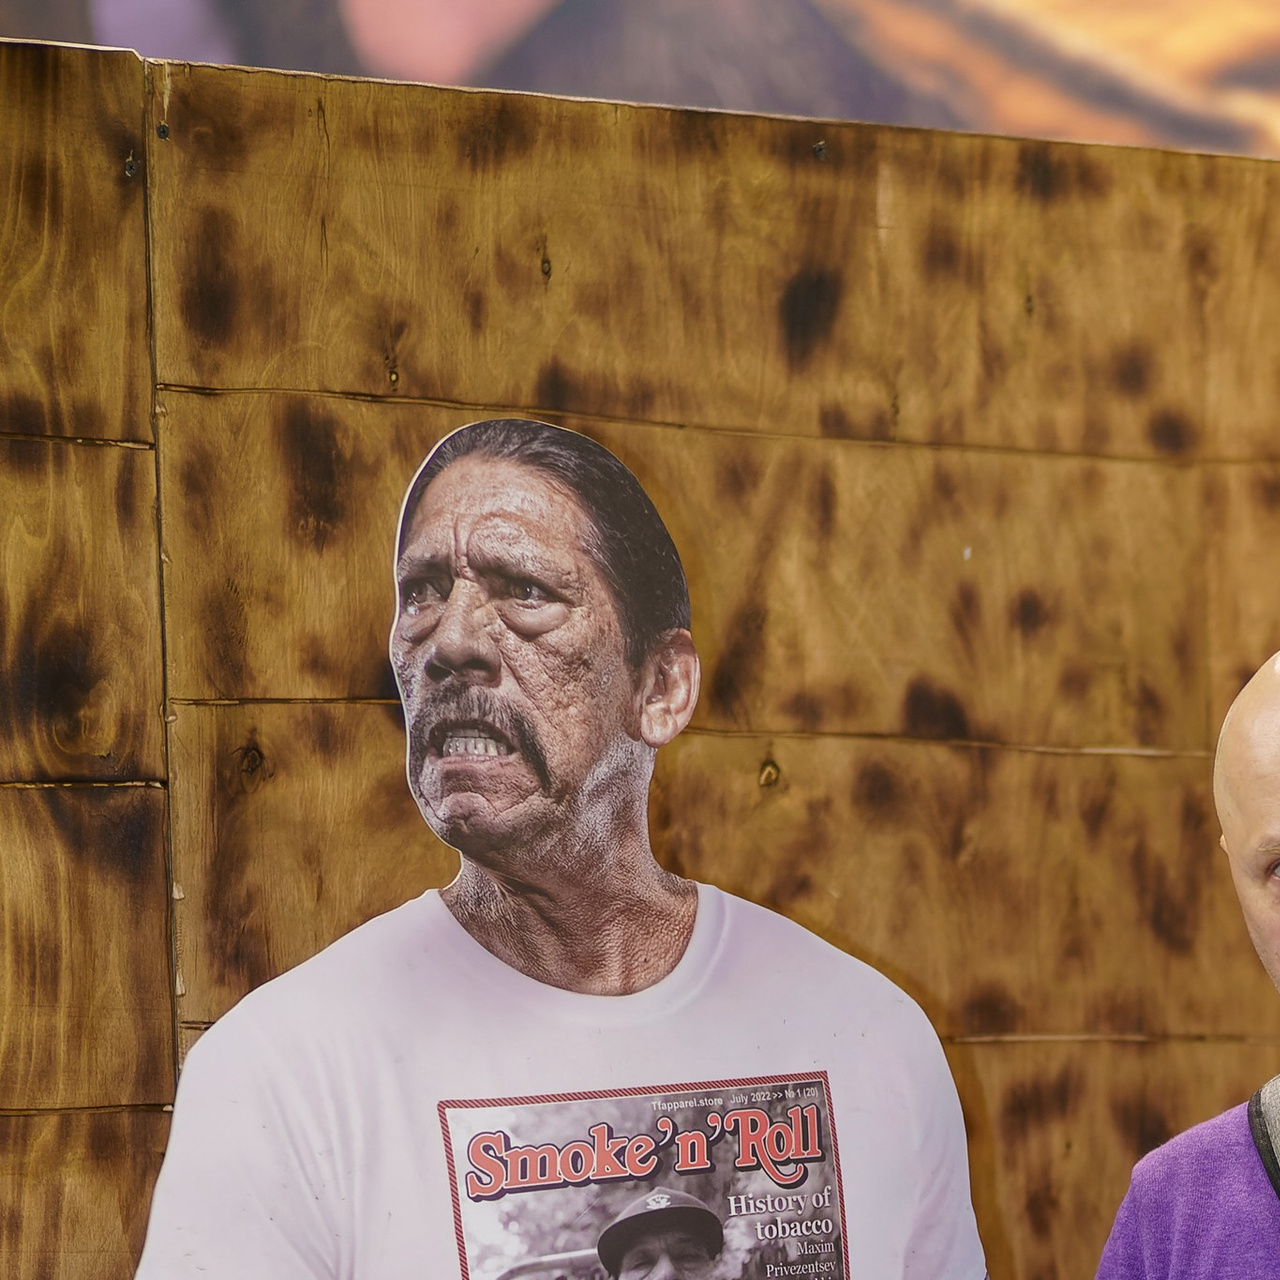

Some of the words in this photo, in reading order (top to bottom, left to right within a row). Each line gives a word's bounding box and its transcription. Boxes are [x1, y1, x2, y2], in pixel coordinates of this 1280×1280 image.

[651, 1097, 723, 1112] Tfapparel.store
[730, 1094, 748, 1105] July
[751, 1092, 772, 1102] 2022
[803, 1087, 818, 1099] (20)
[727, 1193, 807, 1217] History
[812, 1186, 832, 1209] of
[755, 1217, 833, 1240] tobacco
[797, 1240, 835, 1255] Maxim
[766, 1261, 836, 1278] Privezentsev
